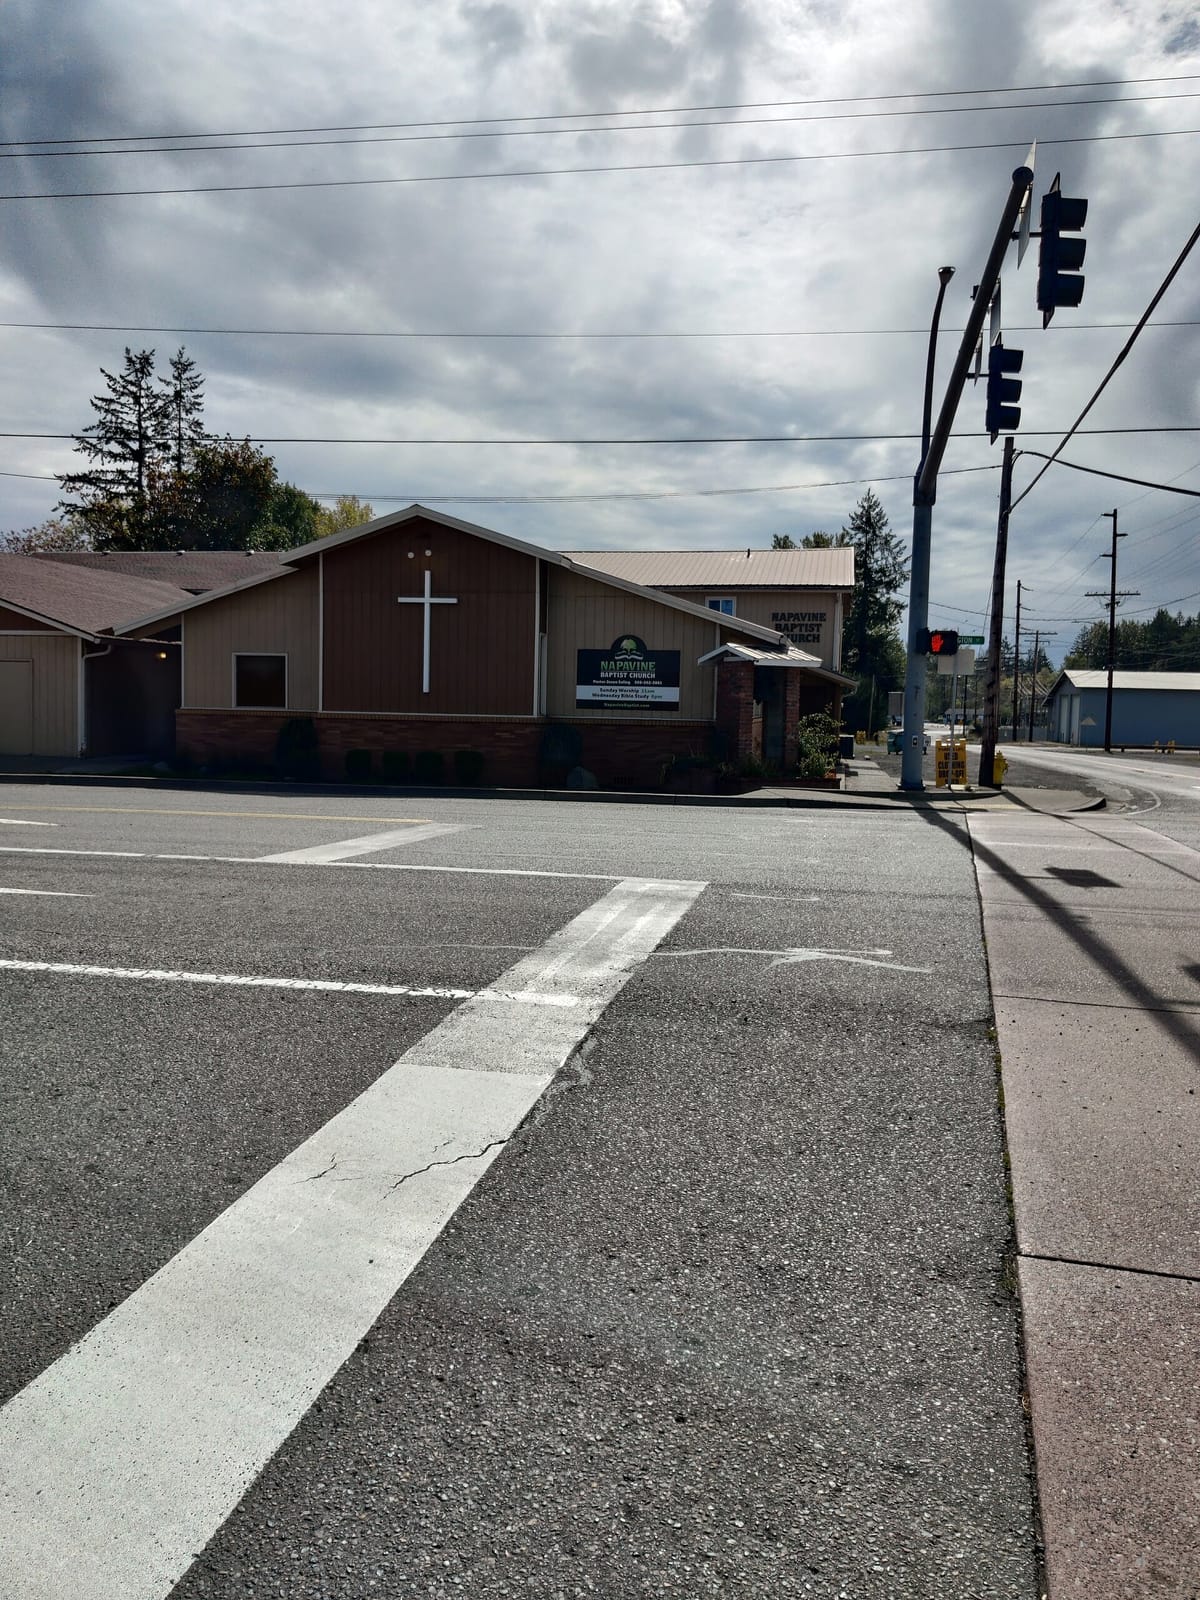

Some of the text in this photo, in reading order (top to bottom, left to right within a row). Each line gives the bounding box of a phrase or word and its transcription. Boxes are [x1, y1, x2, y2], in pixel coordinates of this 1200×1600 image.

[772, 612, 826, 622] NAPAVINE
[775, 623, 822, 633] BAPTIST
[786, 633, 820, 643] URCH
[600, 661, 656, 671] NAPAVINE
[938, 761, 965, 770] CLOHING
